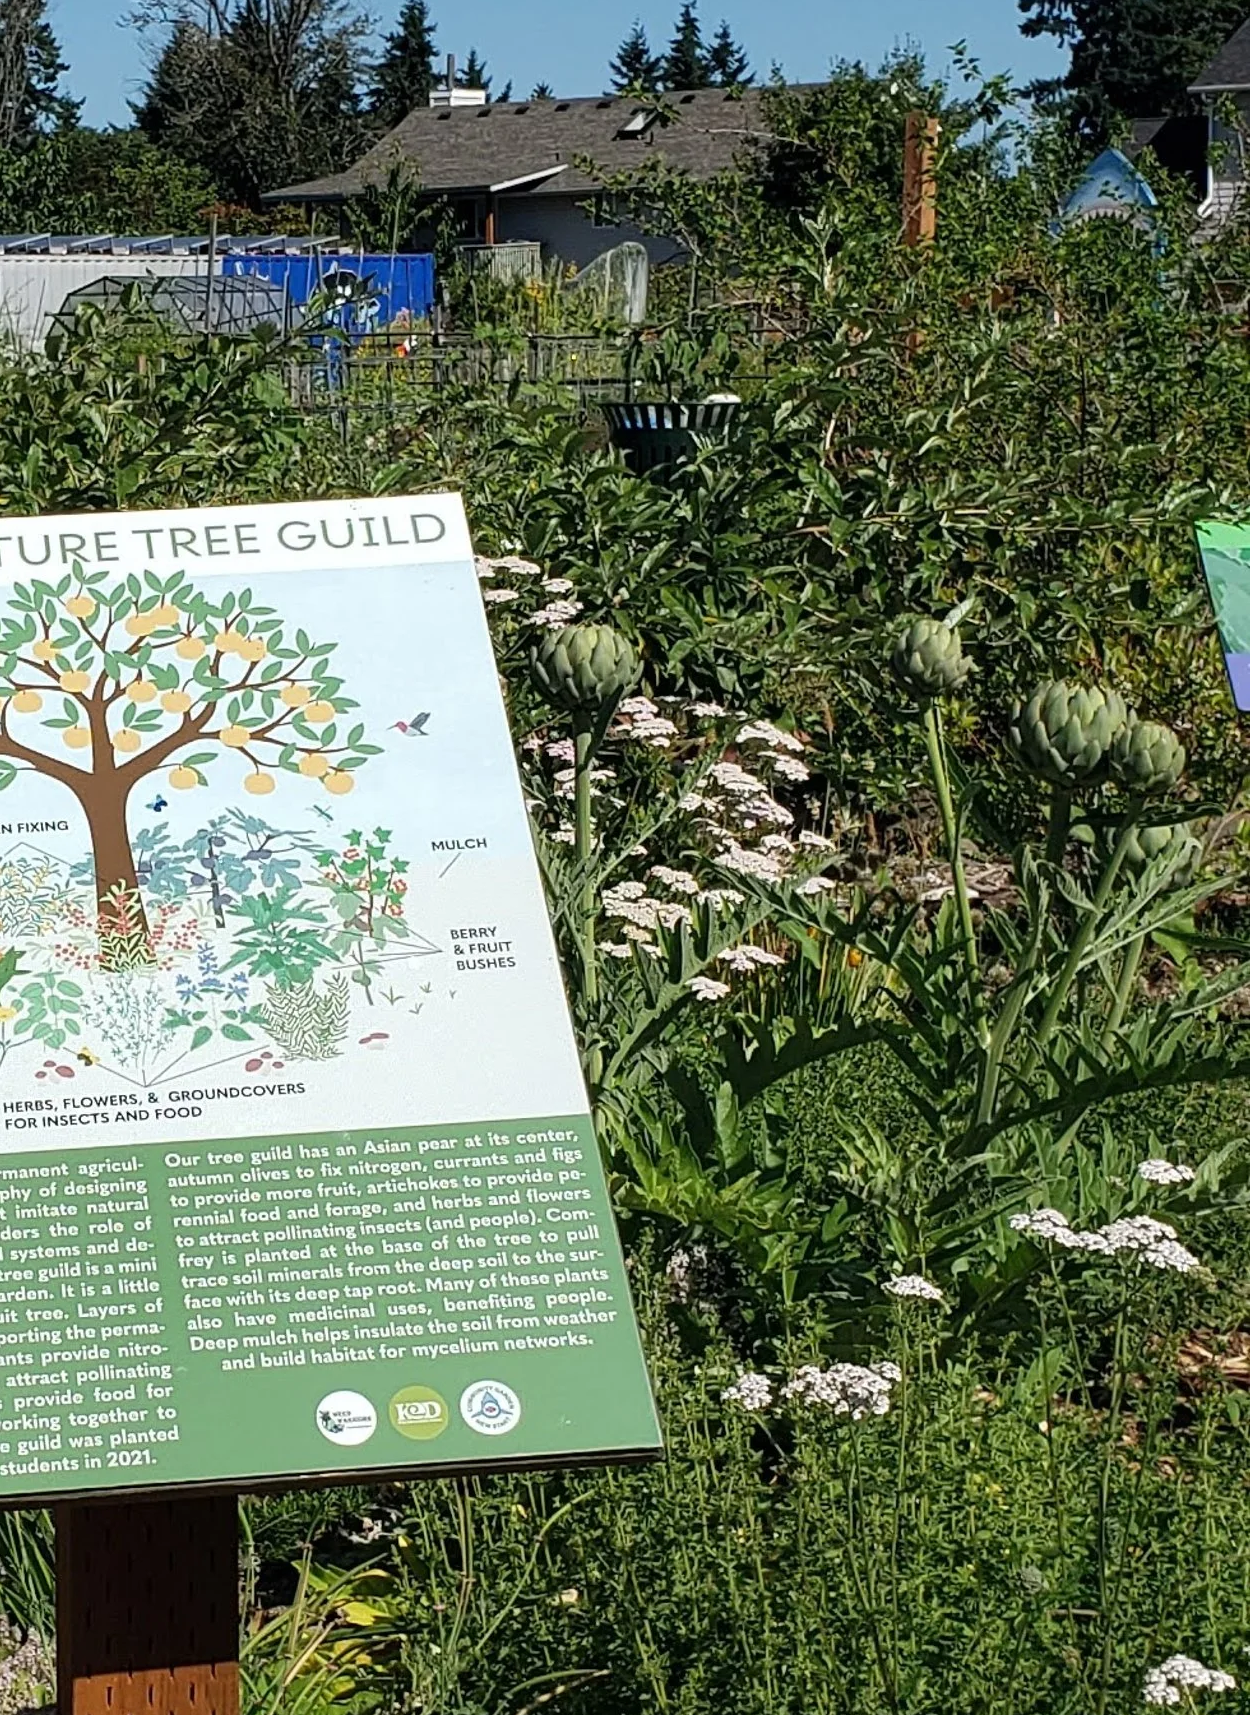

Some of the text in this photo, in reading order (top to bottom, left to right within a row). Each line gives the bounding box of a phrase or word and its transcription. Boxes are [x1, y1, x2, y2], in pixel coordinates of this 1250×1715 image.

[131, 523, 261, 559] TREE
[277, 513, 447, 551] GUILD
[17, 820, 69, 833] FIXING
[431, 837, 488, 851] MULCH
[450, 926, 497, 940] BERRY
[453, 941, 513, 955] & FRUIT
[456, 956, 517, 971] BUSHES
[3, 1083, 306, 1114] HERBS, FLOWERS, & GROUNDCOVERS
[5, 1106, 203, 1130] FOR INSECTS AND FOOD
[164, 1129, 578, 1168] Our tree guild has an Asian pear at its center,
[78, 1156, 144, 1178] agricul-
[168, 1147, 583, 1188] autumn olives to fix nitrogen, currants and figs
[39, 1181, 57, 1197] of
[64, 1177, 148, 1197] designing
[15, 1203, 78, 1219] imitate
[86, 1195, 149, 1215] natural
[173, 1188, 591, 1228] rennial food and forage, and herbs and flowers
[48, 1222, 79, 1238] the
[89, 1218, 124, 1234] role
[133, 1215, 152, 1231] of
[175, 1207, 596, 1248] to attract pollinating insects (and people). Com-
[25, 1309, 69, 1322] tree.
[77, 1303, 137, 1320] Layers
[144, 1297, 163, 1313] of
[187, 1287, 614, 1331] also have medicinal uses, benefiting people.
[190, 1308, 618, 1353] Deep mulch helps insulate the soil from weather
[41, 1344, 110, 1367] provide
[117, 1342, 168, 1358] nitro-
[222, 1330, 594, 1371] and build habitat for mycelium networks.
[68, 1407, 148, 1429] together
[156, 1405, 177, 1420] to
[17, 1433, 62, 1456] guild
[68, 1435, 103, 1448] was
[109, 1424, 180, 1449] planted
[0, 1457, 79, 1476] students
[84, 1453, 102, 1469] in
[106, 1449, 157, 1467] 2021.
